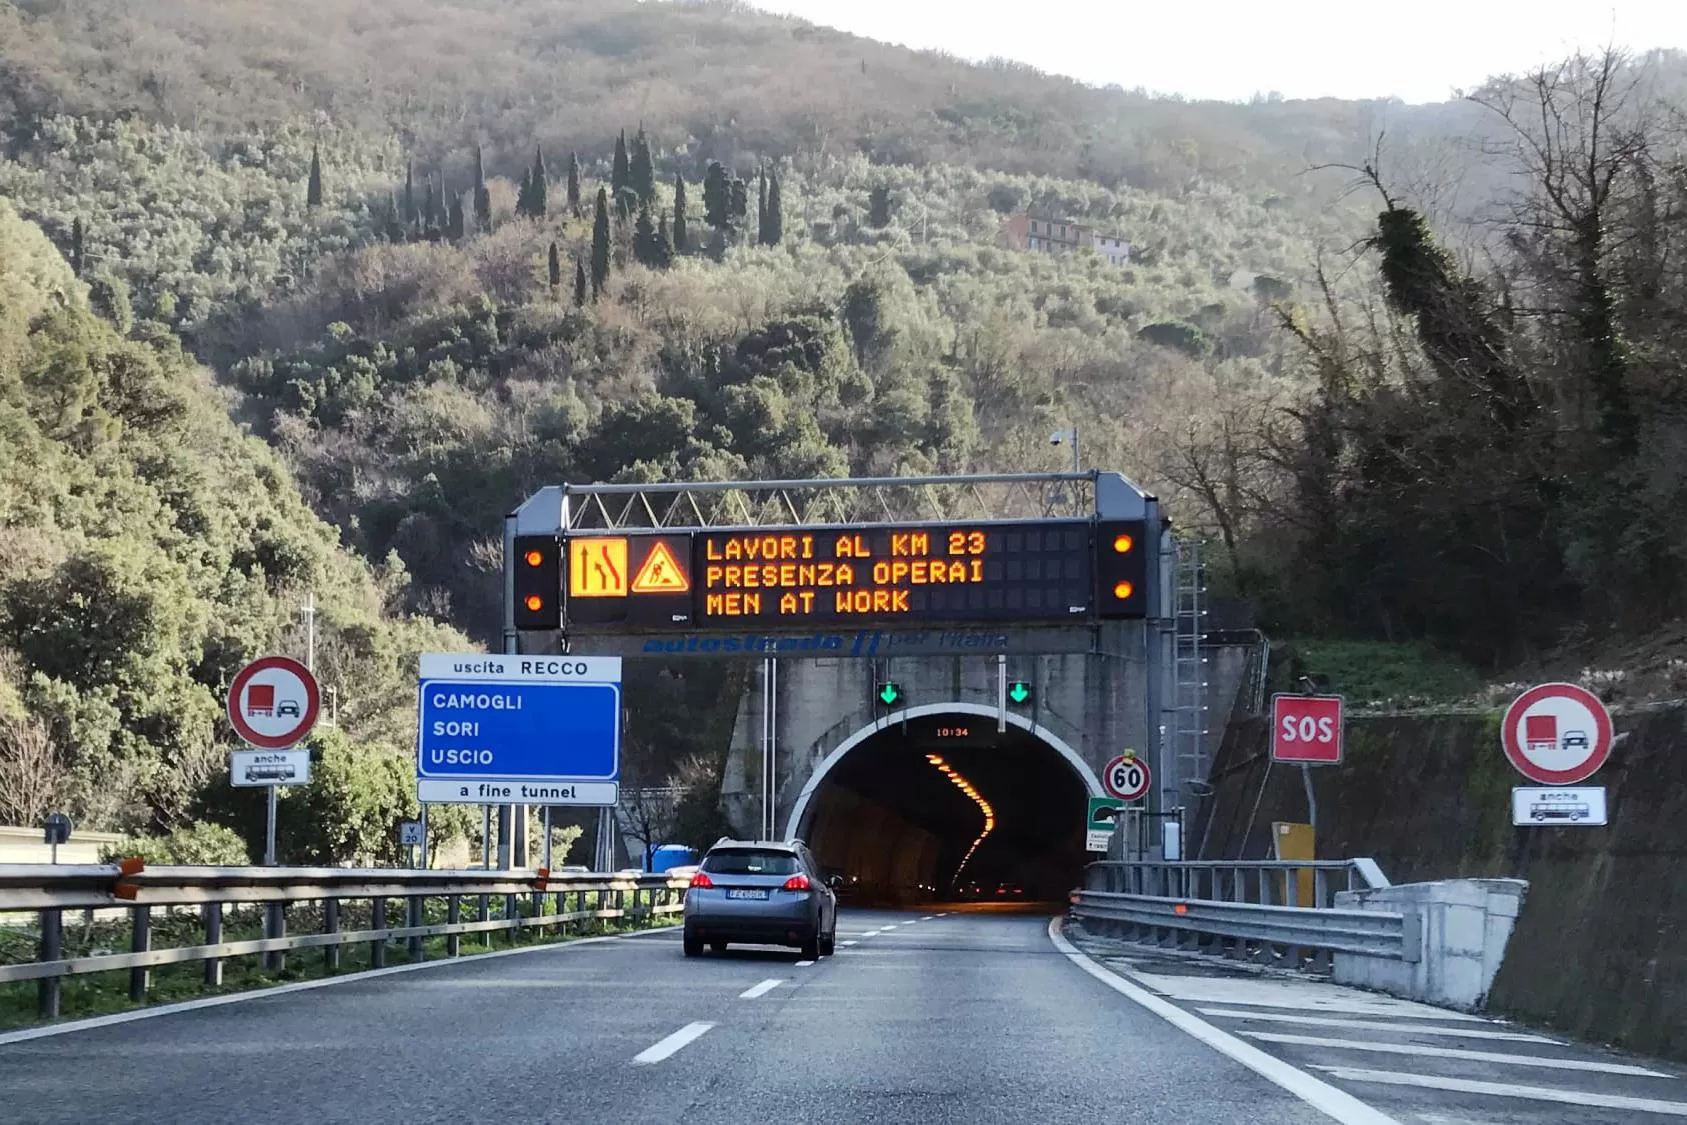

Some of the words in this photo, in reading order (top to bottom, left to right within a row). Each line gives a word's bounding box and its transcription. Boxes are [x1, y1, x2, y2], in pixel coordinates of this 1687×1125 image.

[707, 535, 813, 561] LAVORI
[836, 535, 871, 558] AL
[892, 533, 928, 557] KM
[948, 531, 986, 555] 23
[707, 563, 853, 588] PRESENZA
[873, 559, 983, 585] OPERAI
[707, 592, 760, 616] MEN
[780, 592, 815, 614] AT
[836, 589, 910, 613] WORK
[453, 661, 504, 674] uscita
[521, 661, 588, 675] RECCO
[433, 693, 522, 709] CAMOGLI
[433, 721, 479, 737] SORI
[937, 728, 969, 737] 10:34
[1282, 715, 1333, 743] SOS
[254, 754, 287, 763] anche
[431, 749, 494, 765] USCIO
[1114, 768, 1141, 788] 60
[460, 786, 469, 796] a
[479, 784, 511, 797] fine
[521, 785, 576, 799] tunnel
